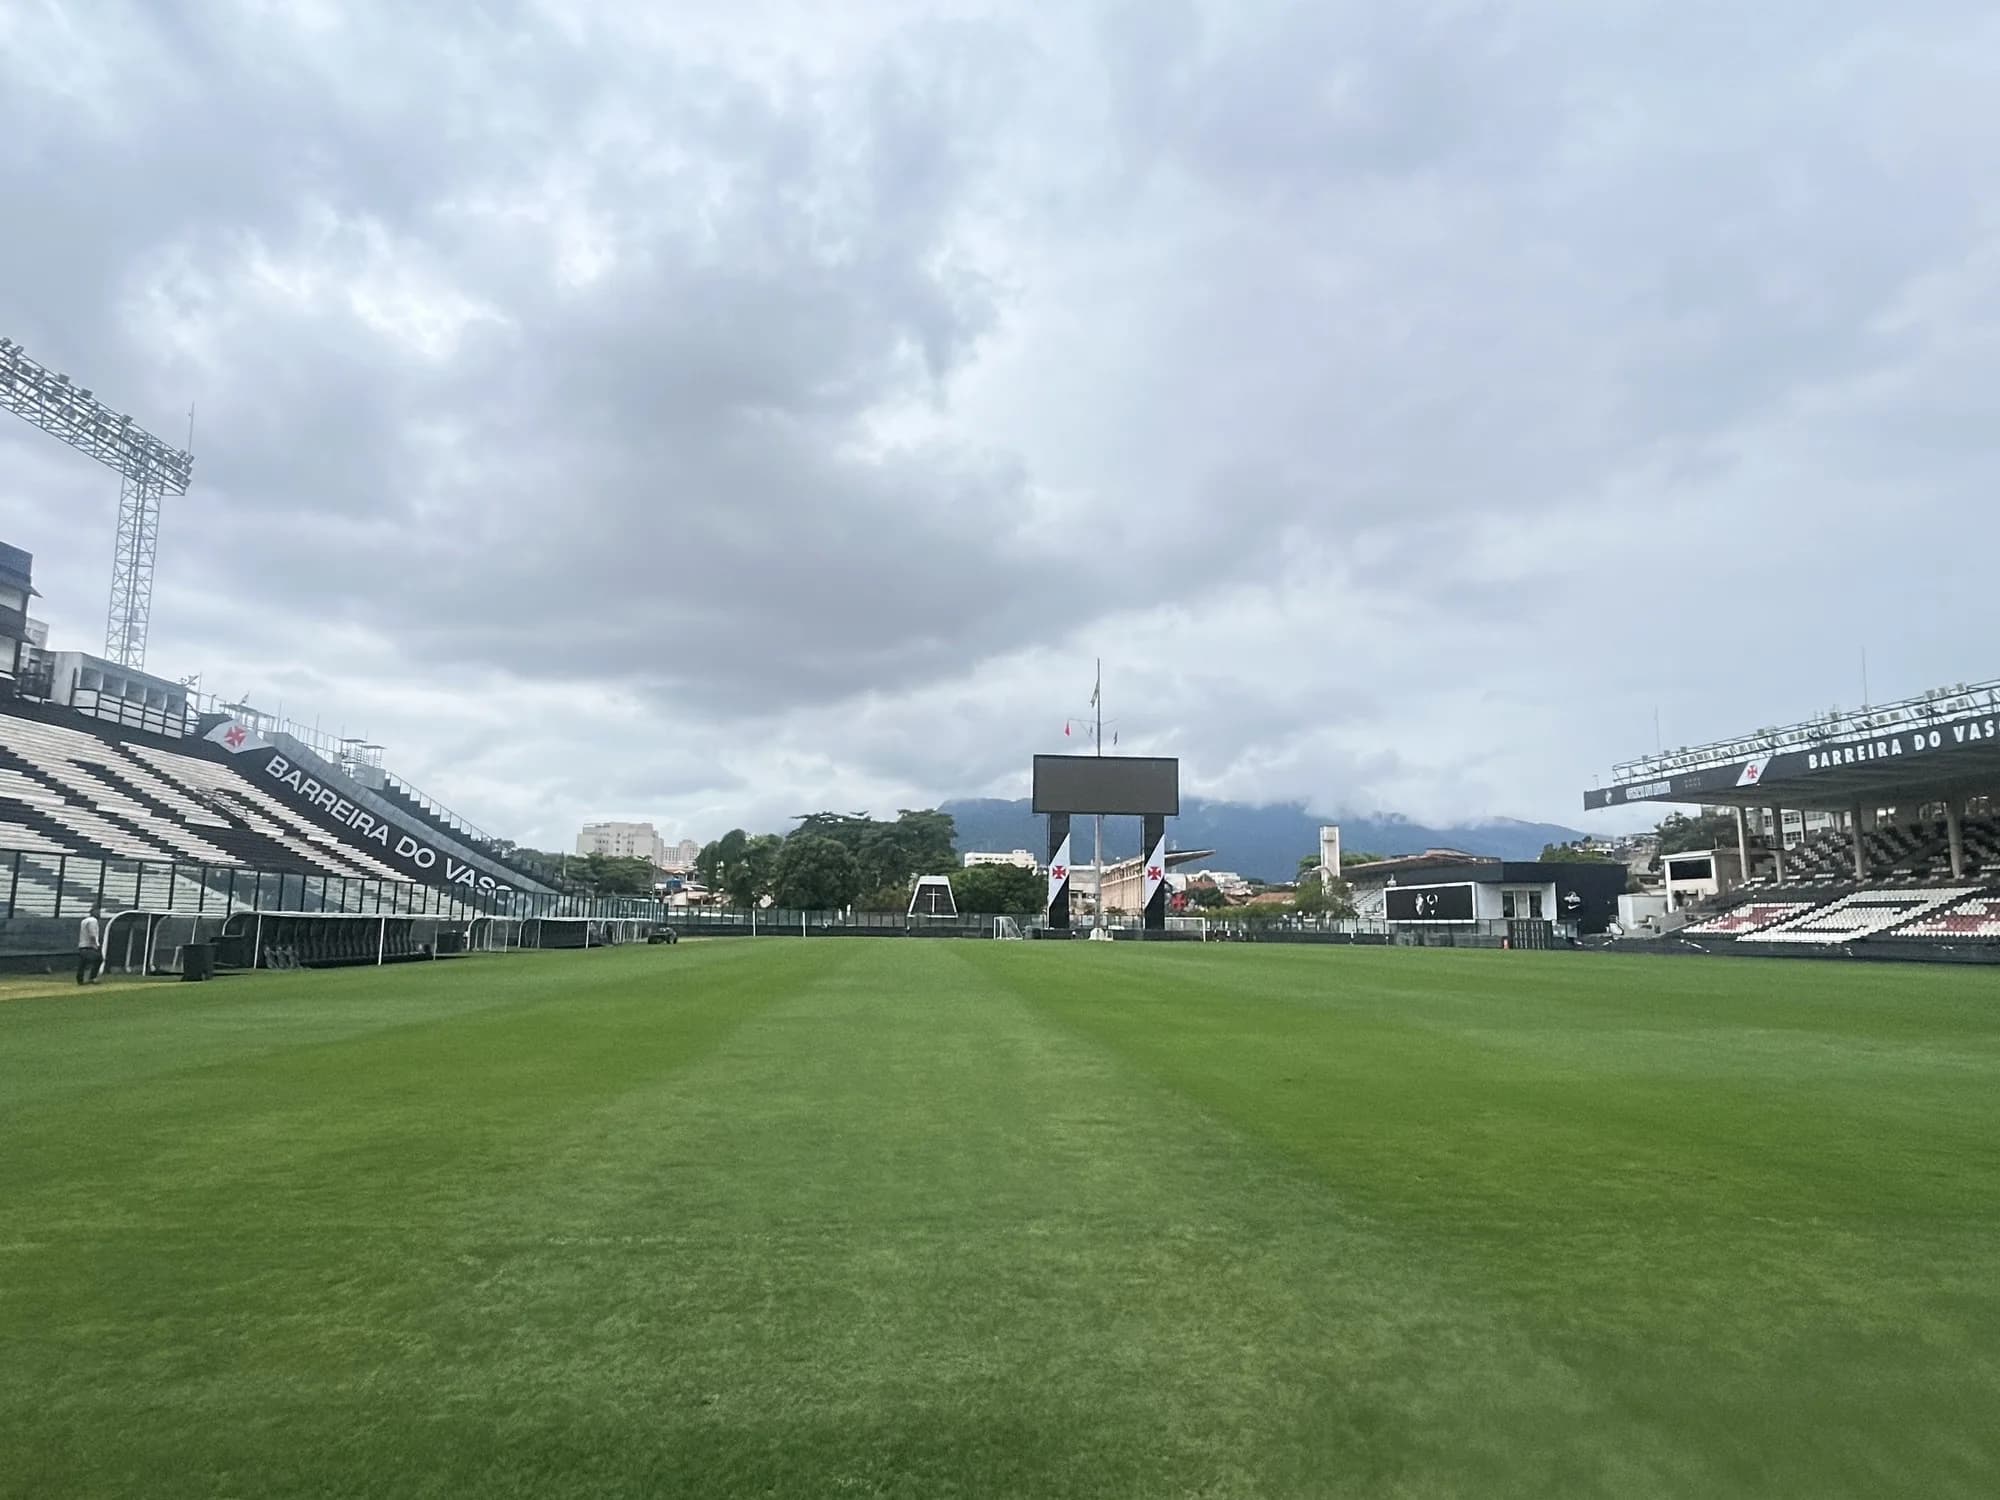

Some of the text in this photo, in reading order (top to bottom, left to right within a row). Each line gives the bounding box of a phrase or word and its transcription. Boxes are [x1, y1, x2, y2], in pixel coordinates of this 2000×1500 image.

[1808, 719, 2000, 769] BARREIRA DO VAS
[265, 755, 389, 847] BARREIRA
[395, 835, 436, 868] DO
